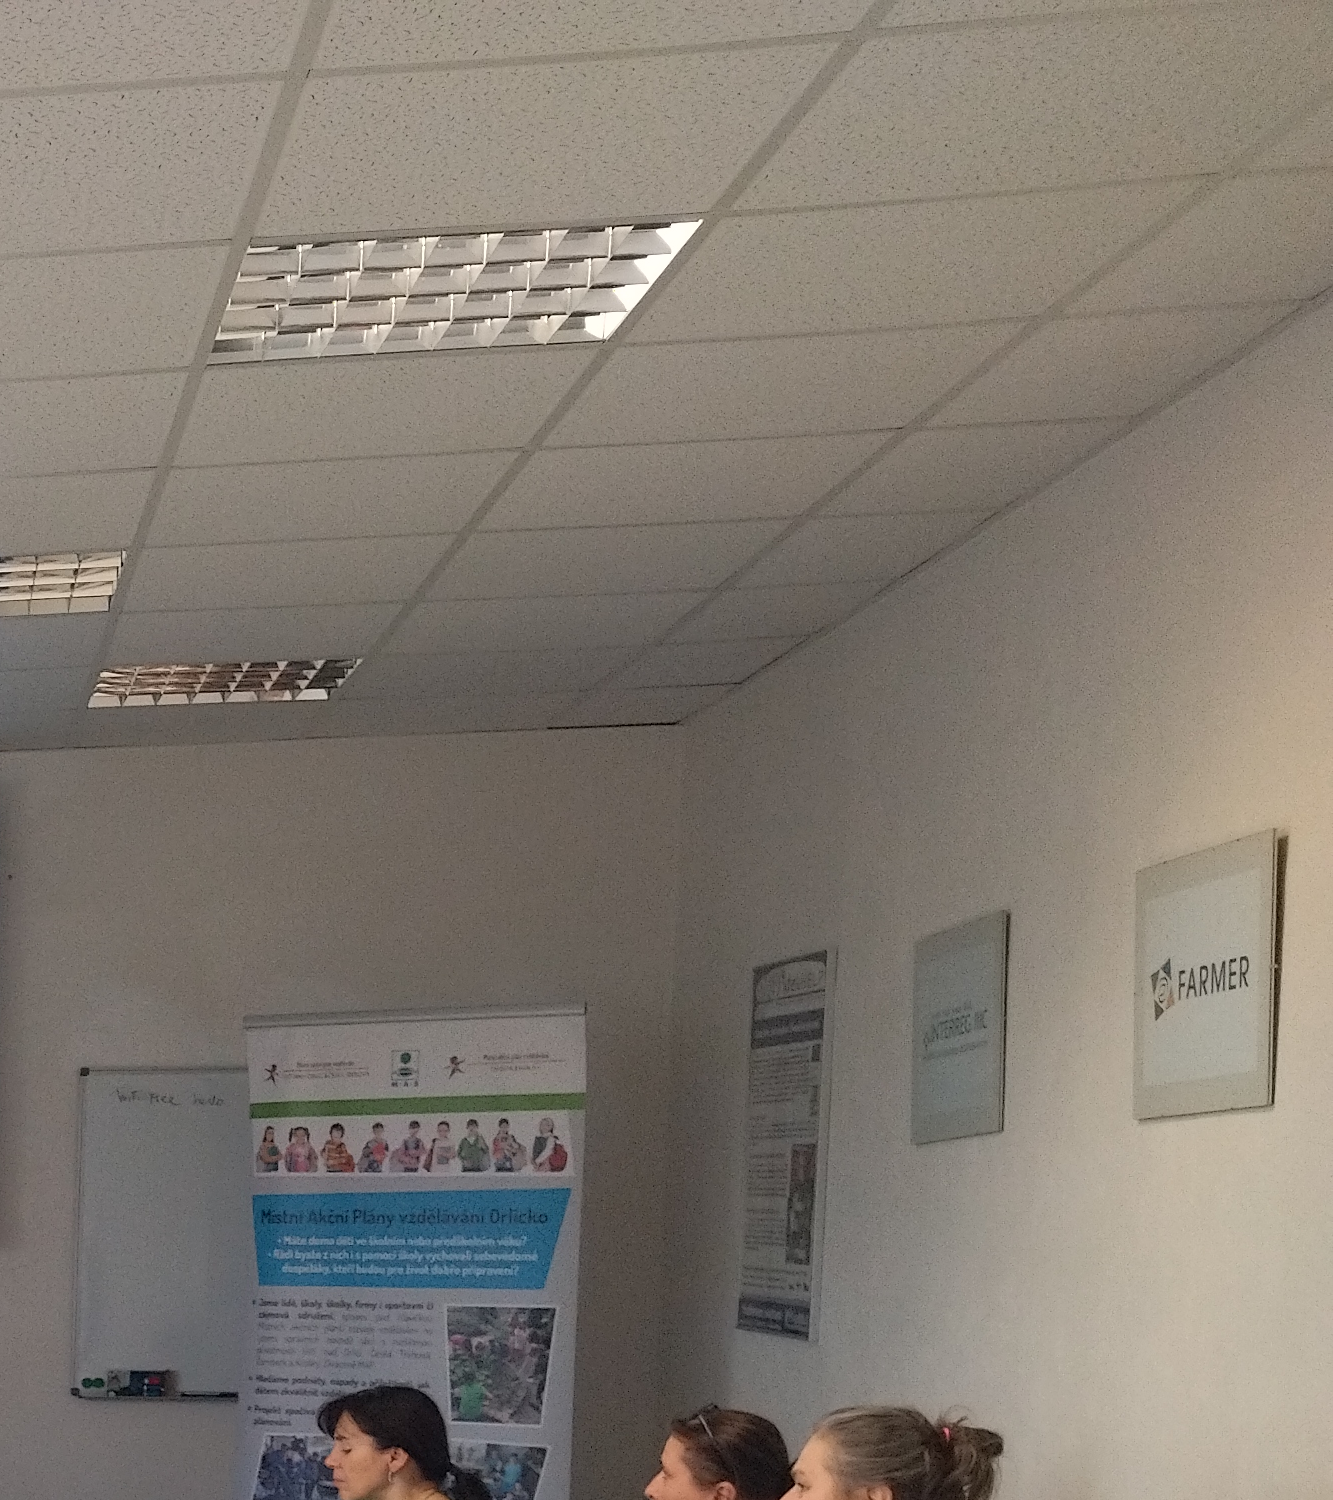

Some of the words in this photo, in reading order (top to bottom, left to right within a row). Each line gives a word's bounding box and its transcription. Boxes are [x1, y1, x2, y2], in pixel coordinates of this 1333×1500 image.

[1178, 955, 1249, 1001] FARMER
[353, 1208, 394, 1228] Plány
[489, 1207, 548, 1224] Orlicko
